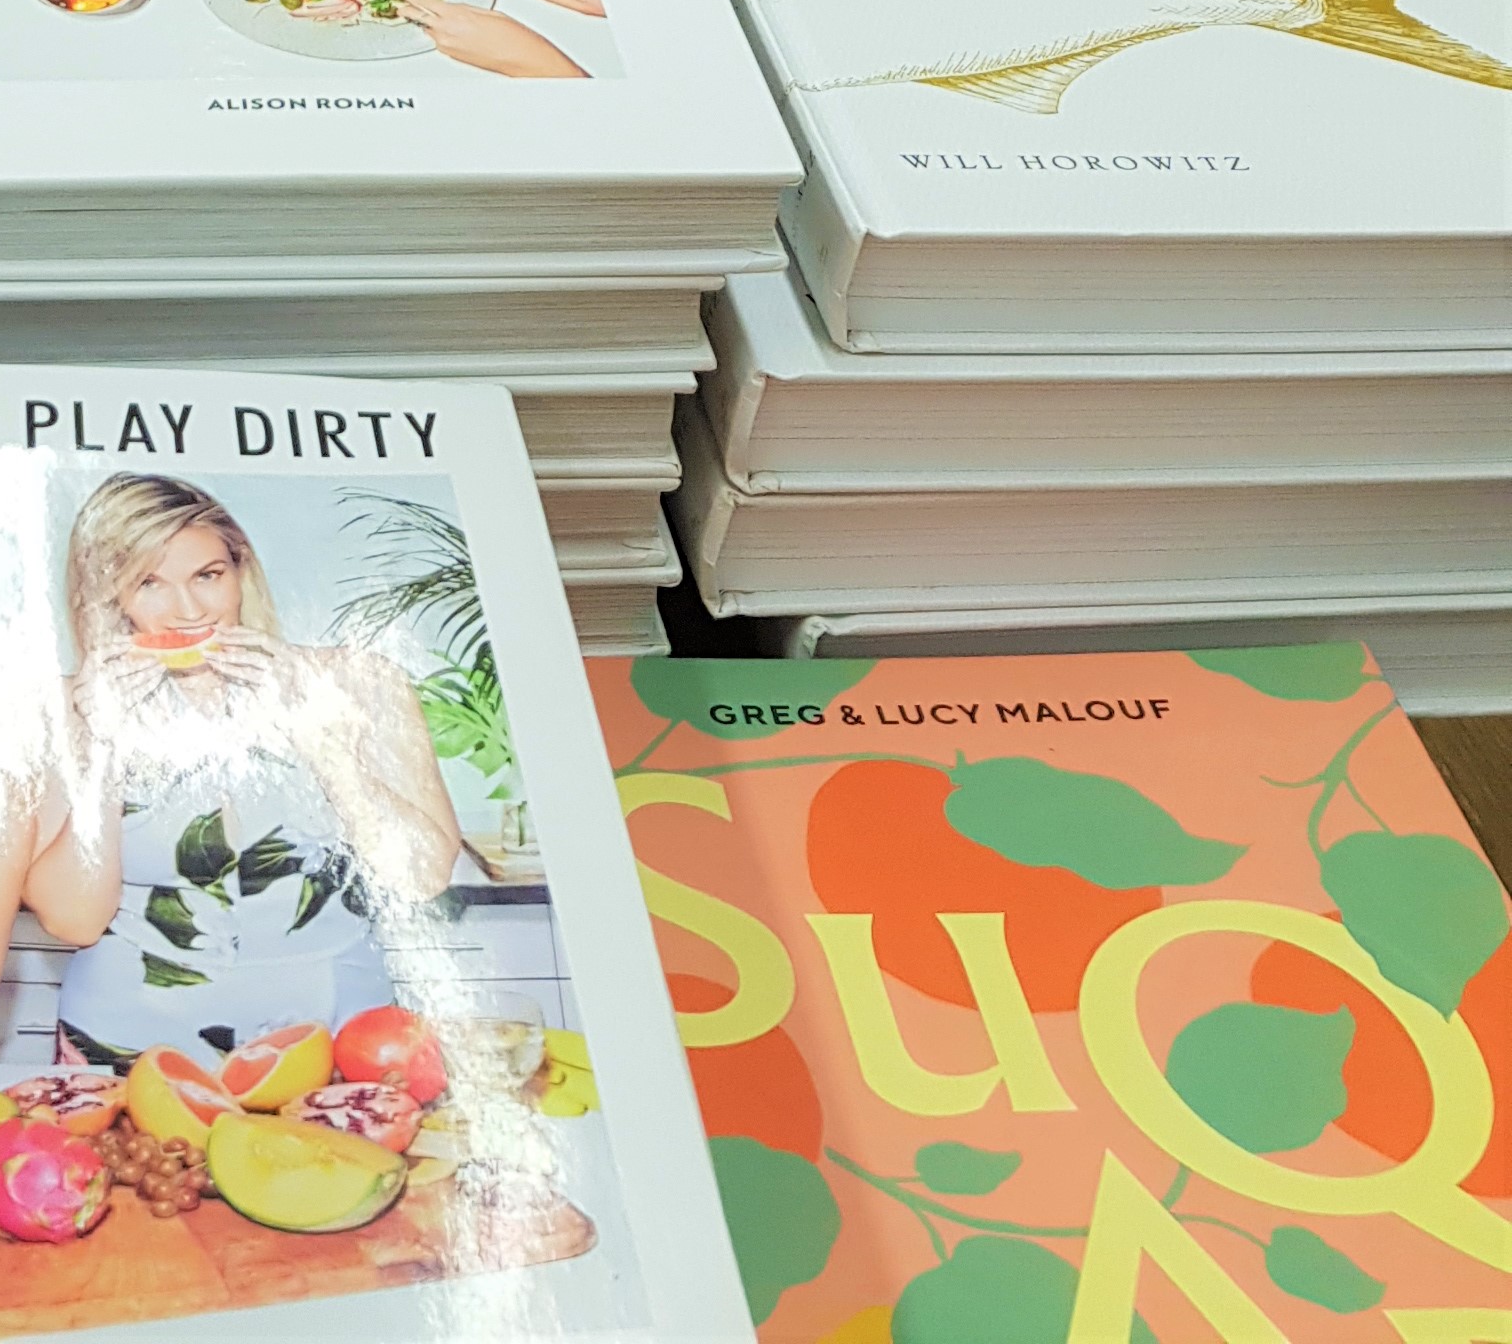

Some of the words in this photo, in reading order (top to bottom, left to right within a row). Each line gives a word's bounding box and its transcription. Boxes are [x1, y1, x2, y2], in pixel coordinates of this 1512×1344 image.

[207, 98, 307, 111] ALISON
[316, 97, 415, 110] ROMAN
[900, 154, 1003, 170] WILL
[1018, 155, 1250, 171] HOROWITZ
[25, 400, 193, 454] PLAY
[234, 406, 436, 458] DIRTY
[709, 704, 825, 726] GREG
[839, 704, 866, 726] &
[875, 703, 979, 725] LUCY
[995, 699, 1170, 724] MALOUF
